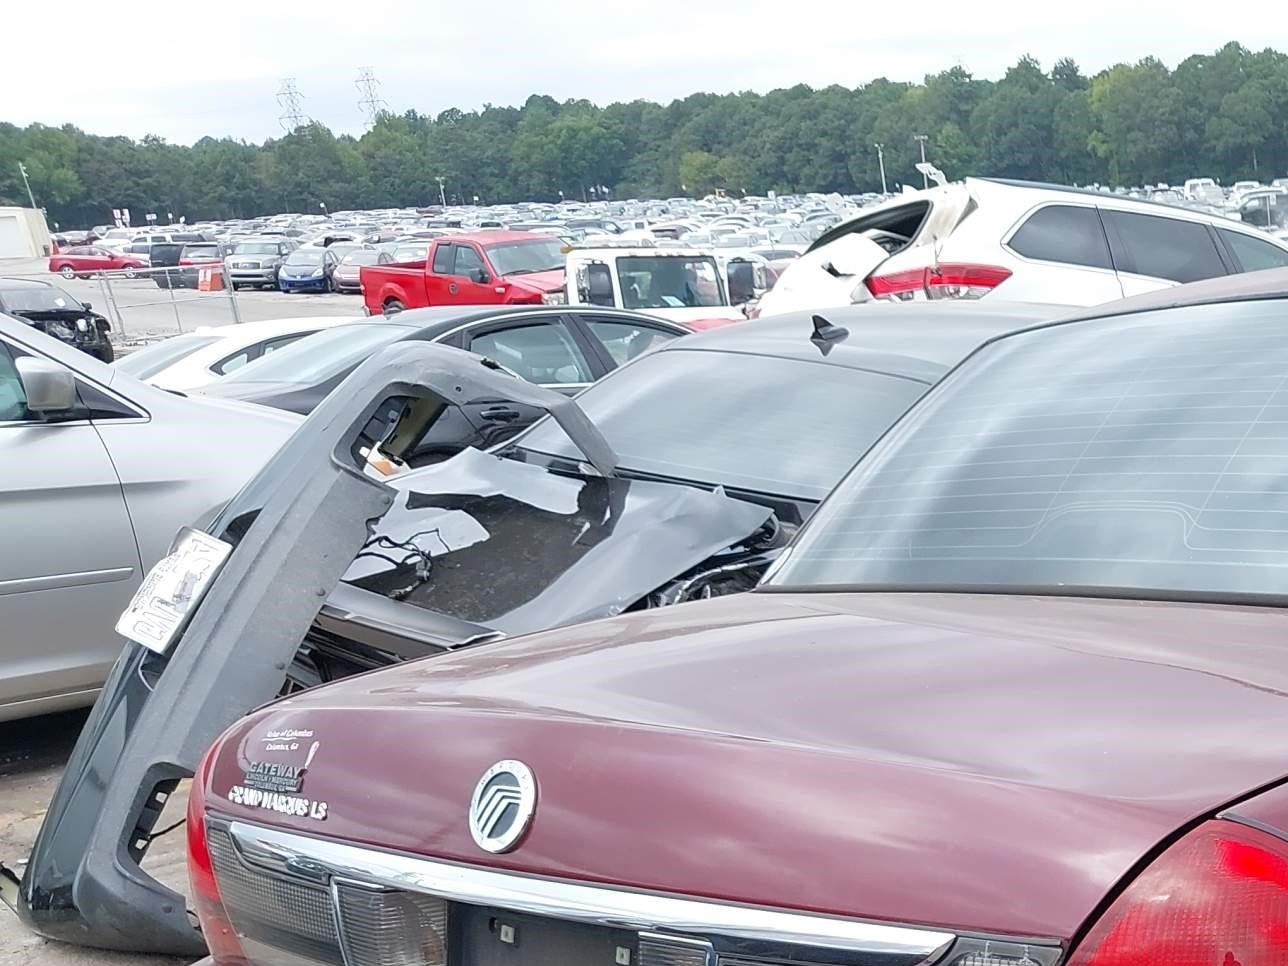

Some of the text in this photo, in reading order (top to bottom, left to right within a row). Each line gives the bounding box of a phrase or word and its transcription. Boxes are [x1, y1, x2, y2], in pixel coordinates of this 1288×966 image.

[248, 761, 302, 779] GATEWAY
[227, 785, 263, 807] GRAND
[261, 791, 310, 817] MARQUIS
[310, 800, 329, 821] LS
